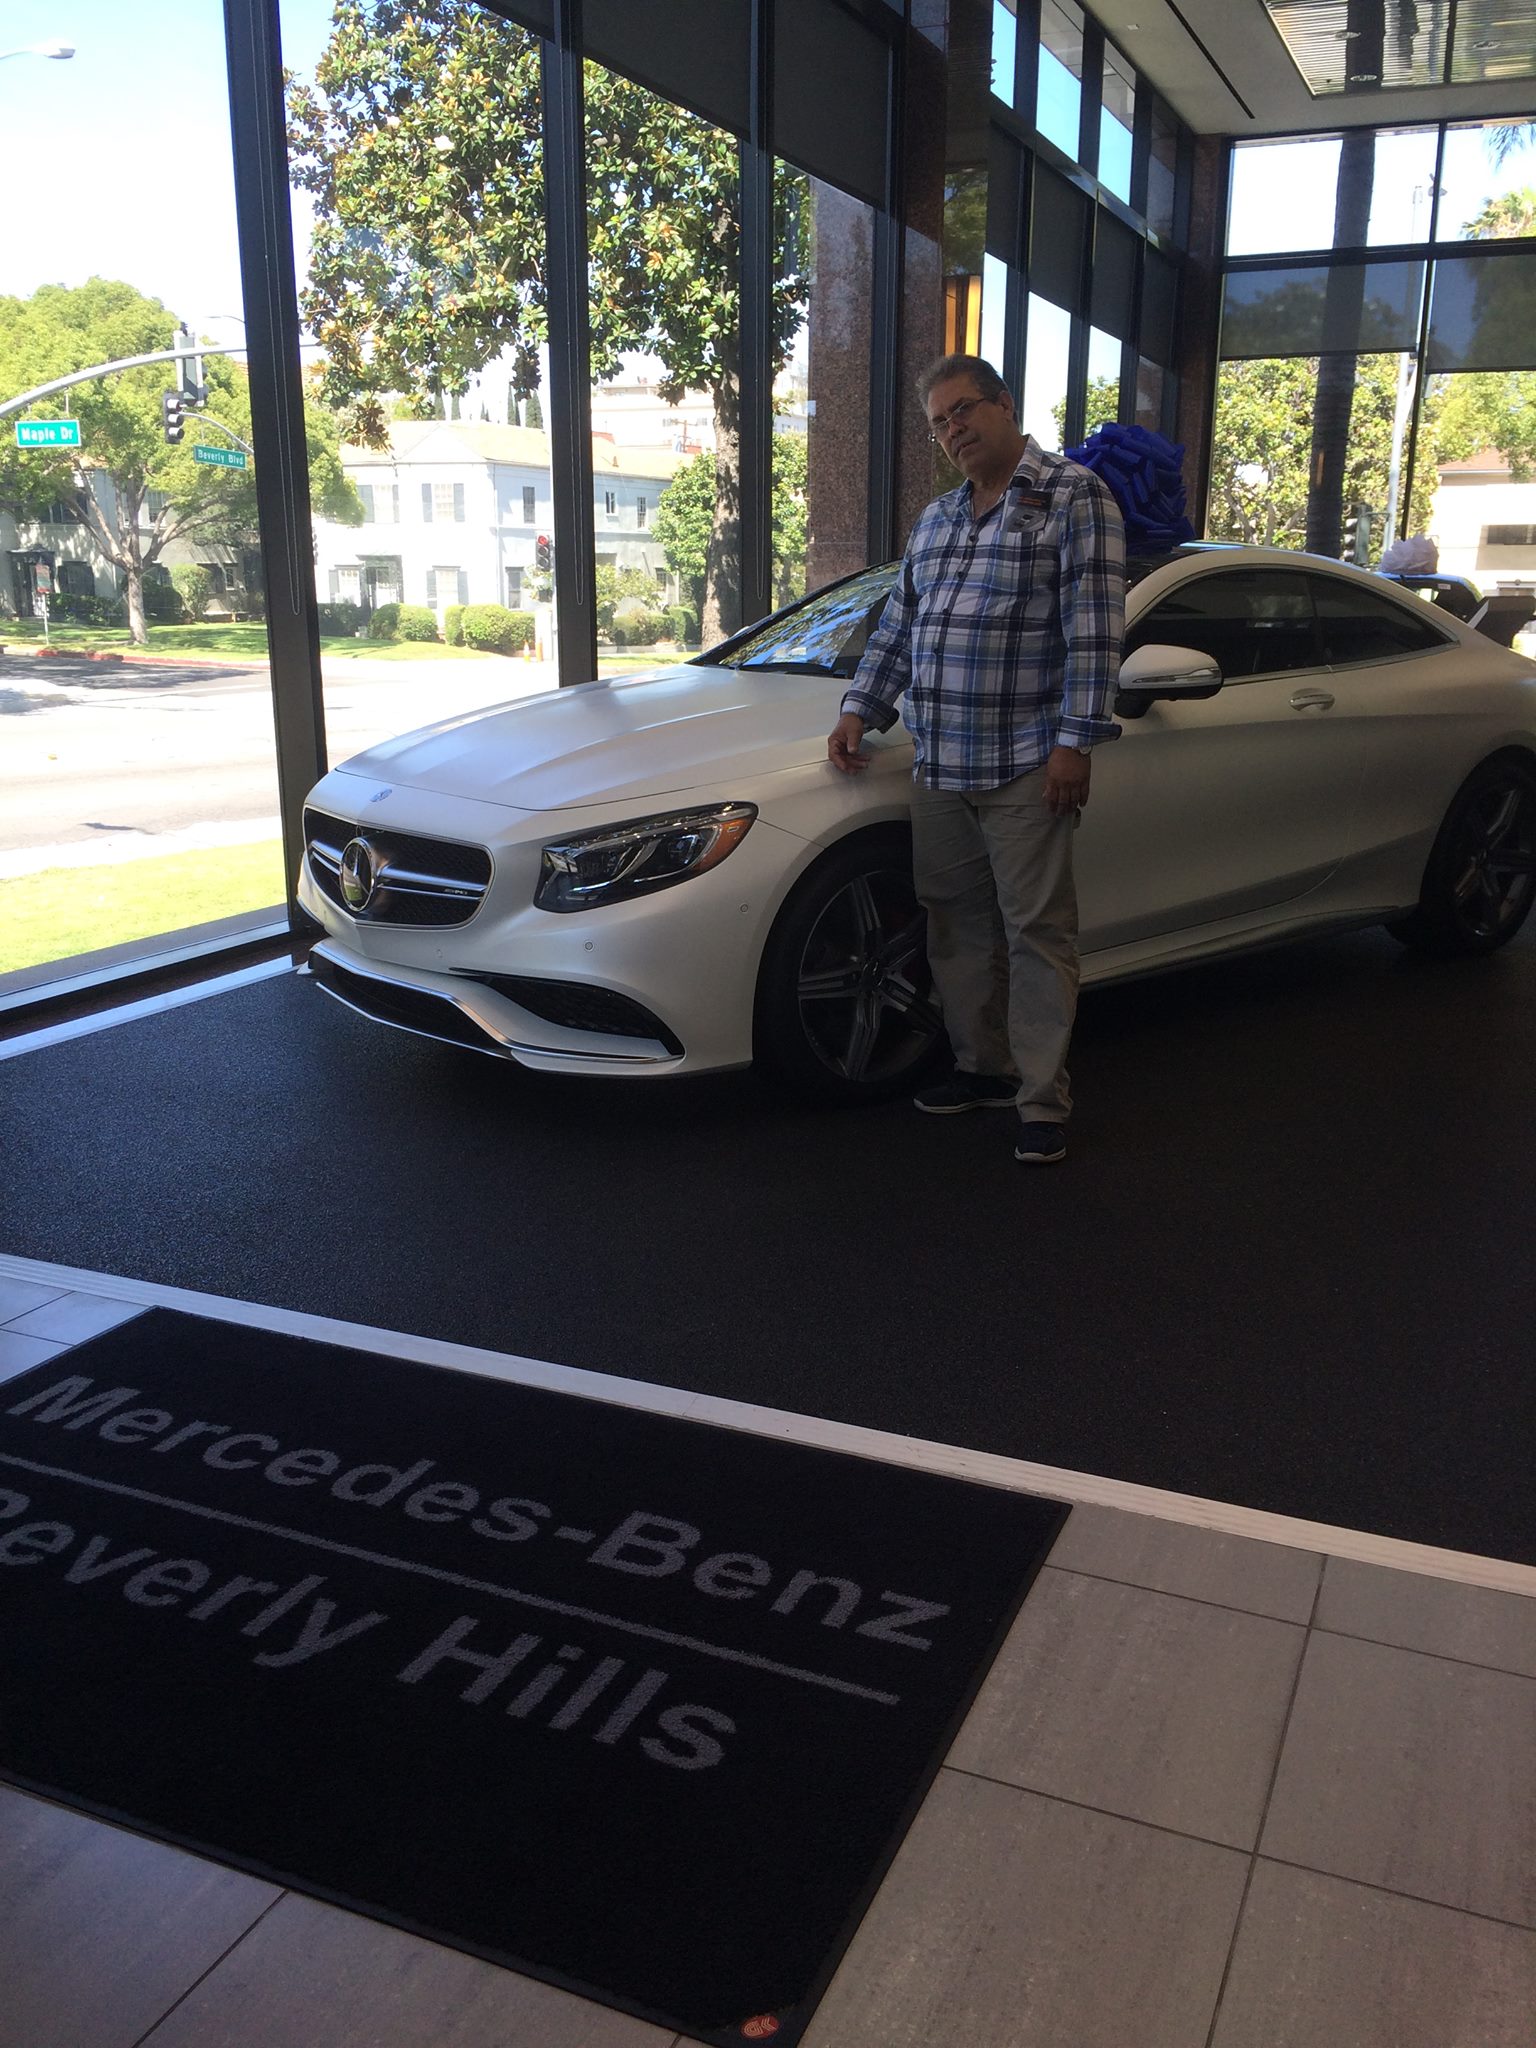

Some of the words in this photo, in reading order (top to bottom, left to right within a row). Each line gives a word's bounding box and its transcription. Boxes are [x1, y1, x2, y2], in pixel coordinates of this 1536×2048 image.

[21, 427, 56, 443] Maple
[60, 426, 73, 440] Dr
[198, 449, 225, 464] Beverly
[228, 454, 244, 465] Blvd
[5, 1373, 952, 1652] Mercedes-Benz
[397, 1613, 739, 1772] Hills
